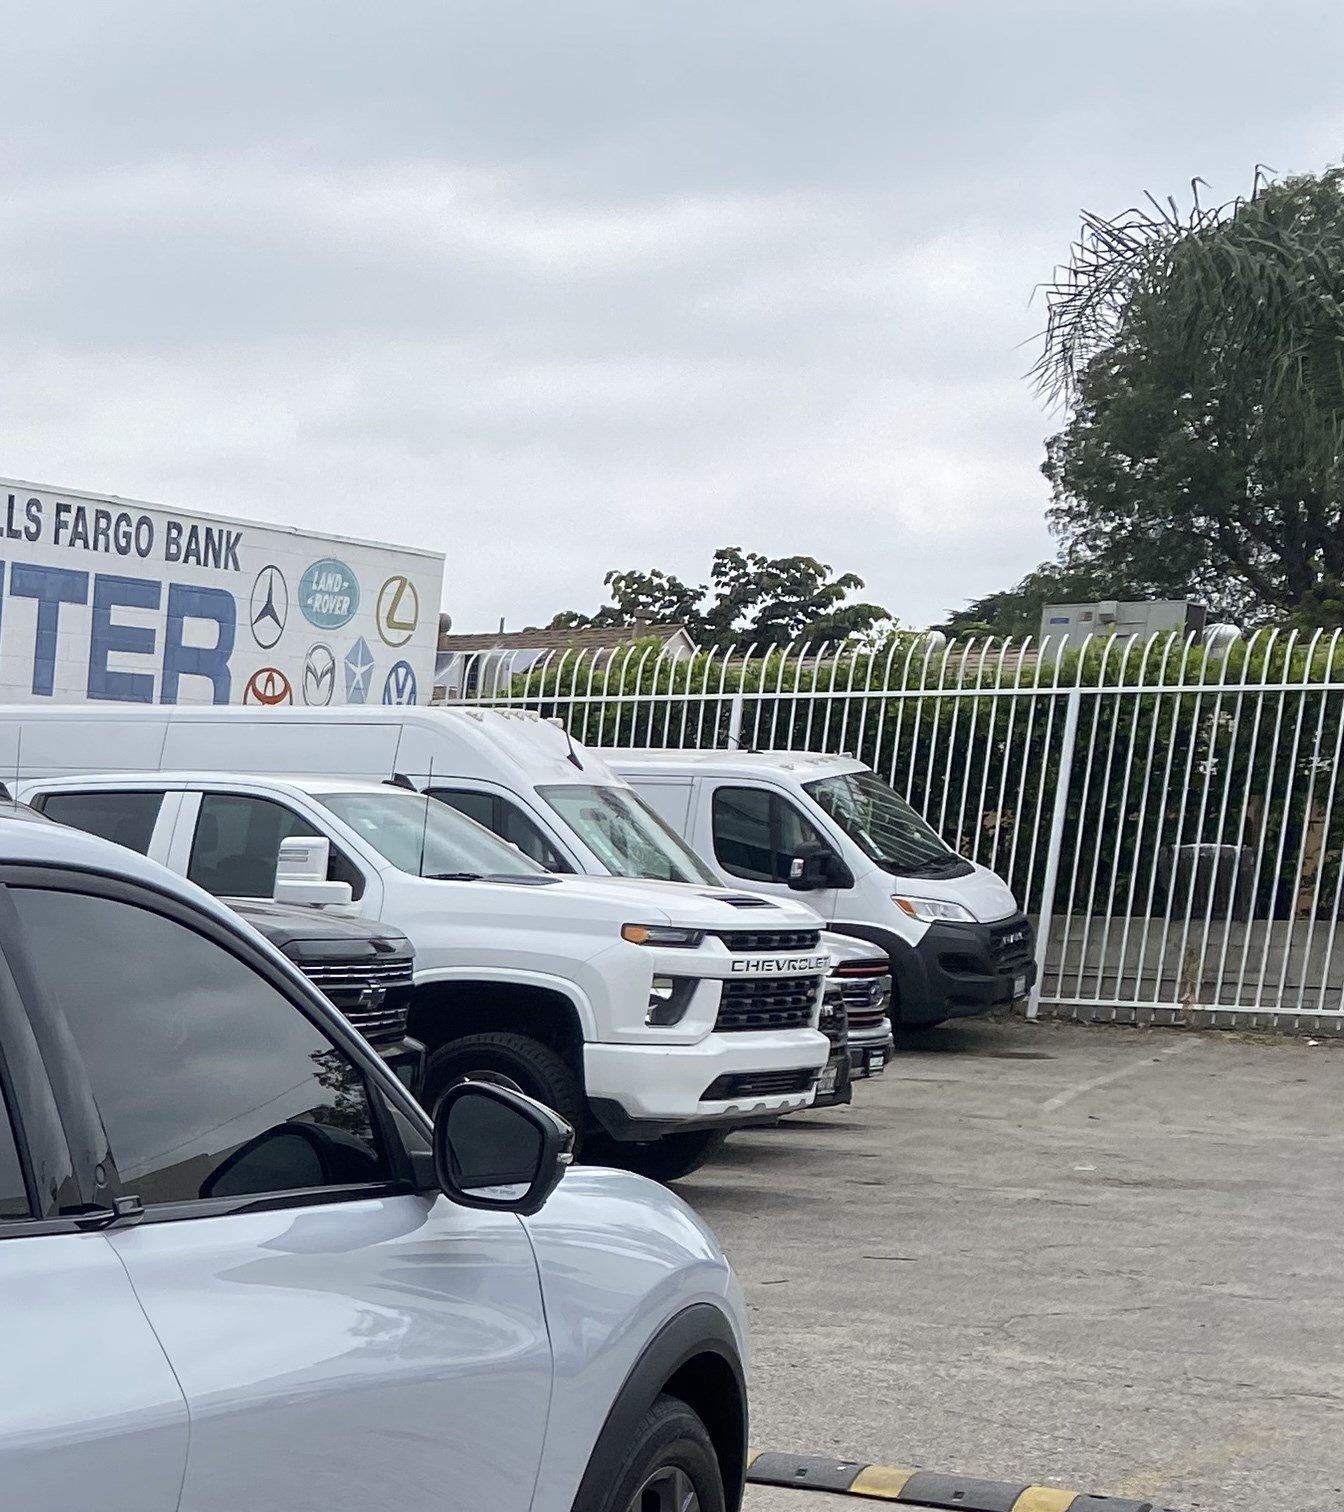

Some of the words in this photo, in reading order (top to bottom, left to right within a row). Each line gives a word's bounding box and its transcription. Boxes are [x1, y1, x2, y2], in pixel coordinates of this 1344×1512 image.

[53, 502, 154, 559] FARGO
[165, 520, 244, 572] BANK
[730, 956, 829, 973] CHEVROLET
